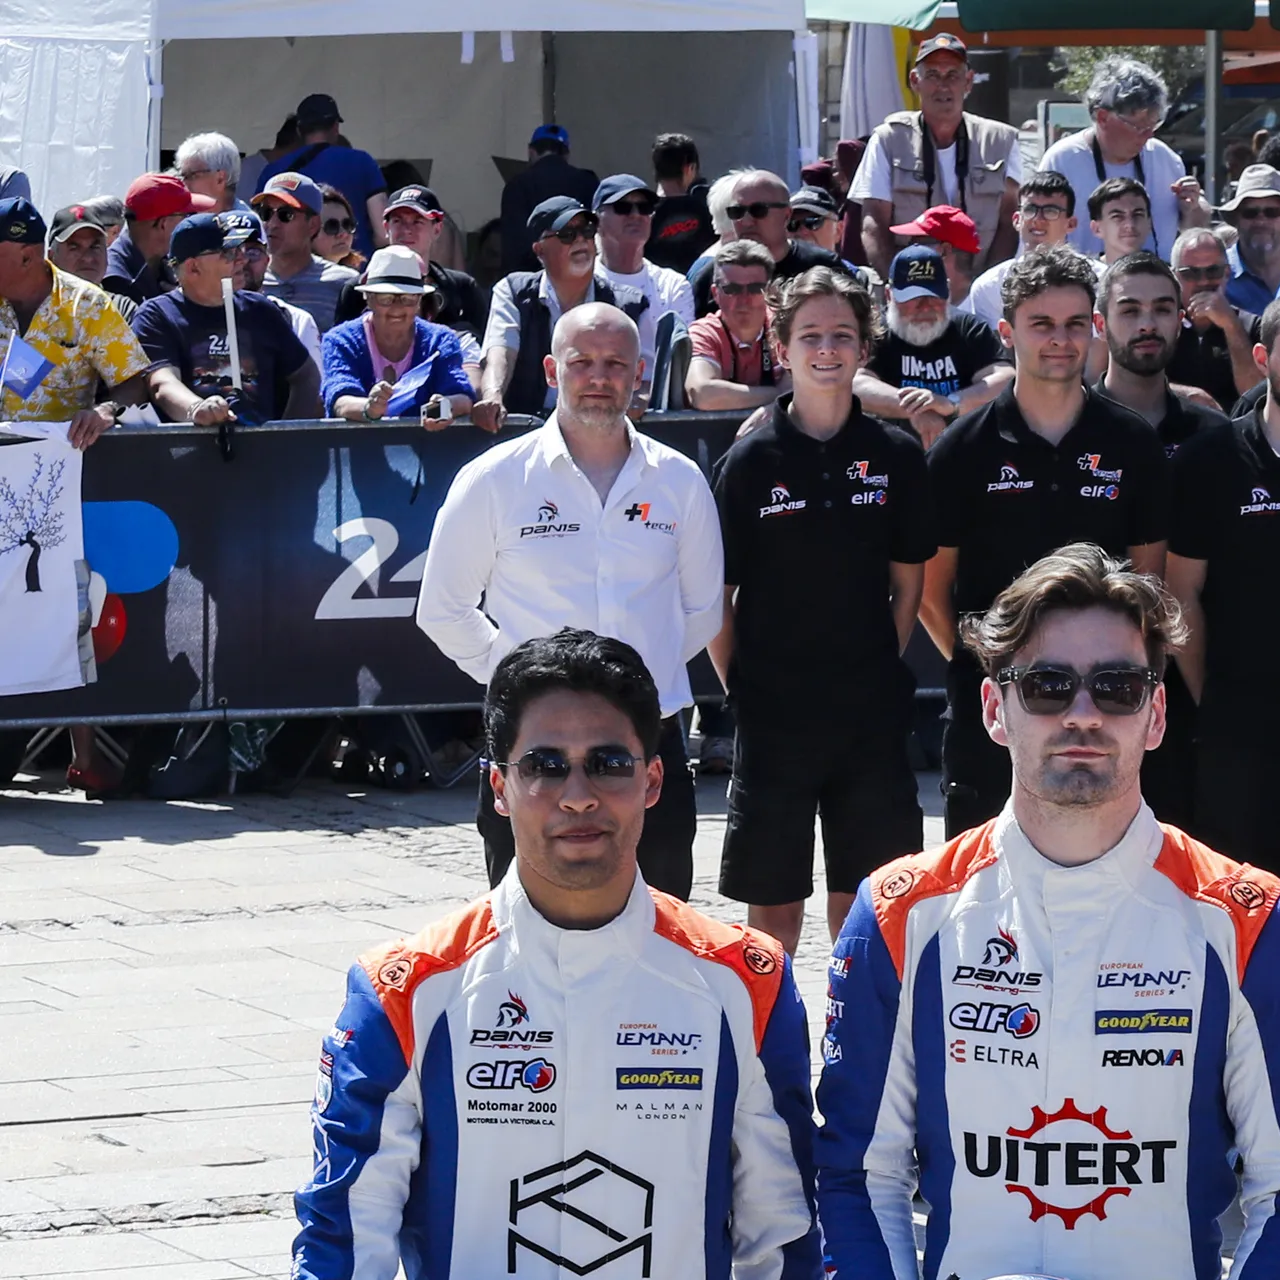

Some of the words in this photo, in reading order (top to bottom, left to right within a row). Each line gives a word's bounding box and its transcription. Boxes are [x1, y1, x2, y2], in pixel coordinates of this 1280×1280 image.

[852, 490, 876, 506] elf
[1081, 484, 1106, 499] elf
[1100, 962, 1144, 970] EUROPEAN
[1134, 989, 1165, 998] SERIES
[951, 1003, 1007, 1031] elf
[651, 1048, 679, 1056] SERIES
[974, 1045, 1040, 1070] ELTRA
[1102, 1049, 1185, 1067] RENOVA
[468, 1060, 523, 1088] elf
[468, 1100, 524, 1113] Motomar
[528, 1100, 557, 1114] 2000
[616, 1103, 703, 1111] MALMAN
[510, 1118, 541, 1126] VICTORIA
[963, 1131, 1178, 1186] UITERT
